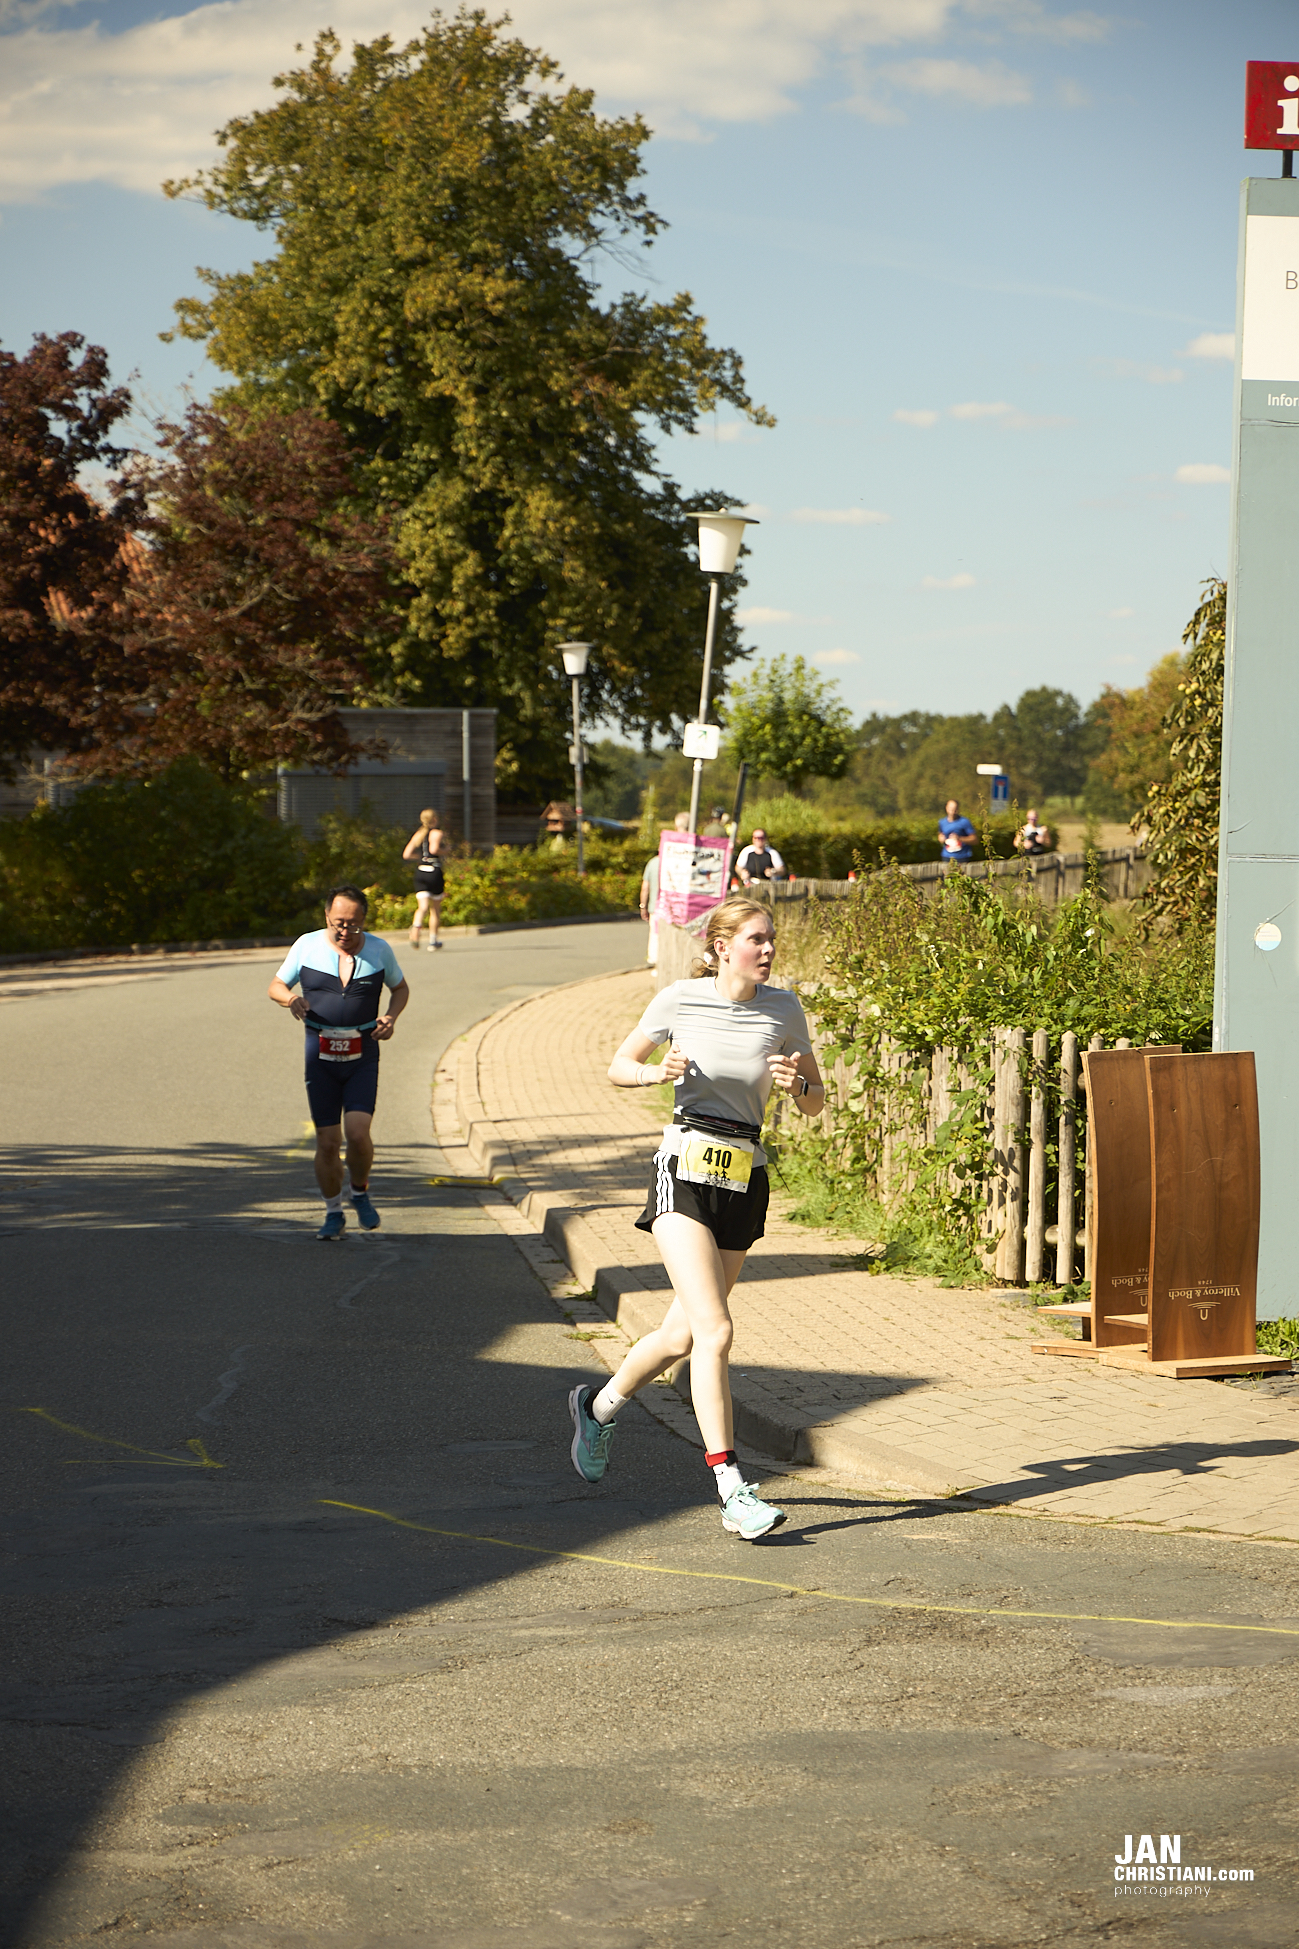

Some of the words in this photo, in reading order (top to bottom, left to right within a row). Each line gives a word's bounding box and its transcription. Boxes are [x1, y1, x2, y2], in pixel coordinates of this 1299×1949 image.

[1268, 393, 1299, 407] Infor
[329, 1040, 351, 1052] 252
[702, 1147, 732, 1169] 410
[1111, 1277, 1134, 1288] Boch
[1168, 1289, 1193, 1300] Boch
[1195, 1289, 1201, 1298] &
[1202, 1286, 1241, 1297] Villeroy
